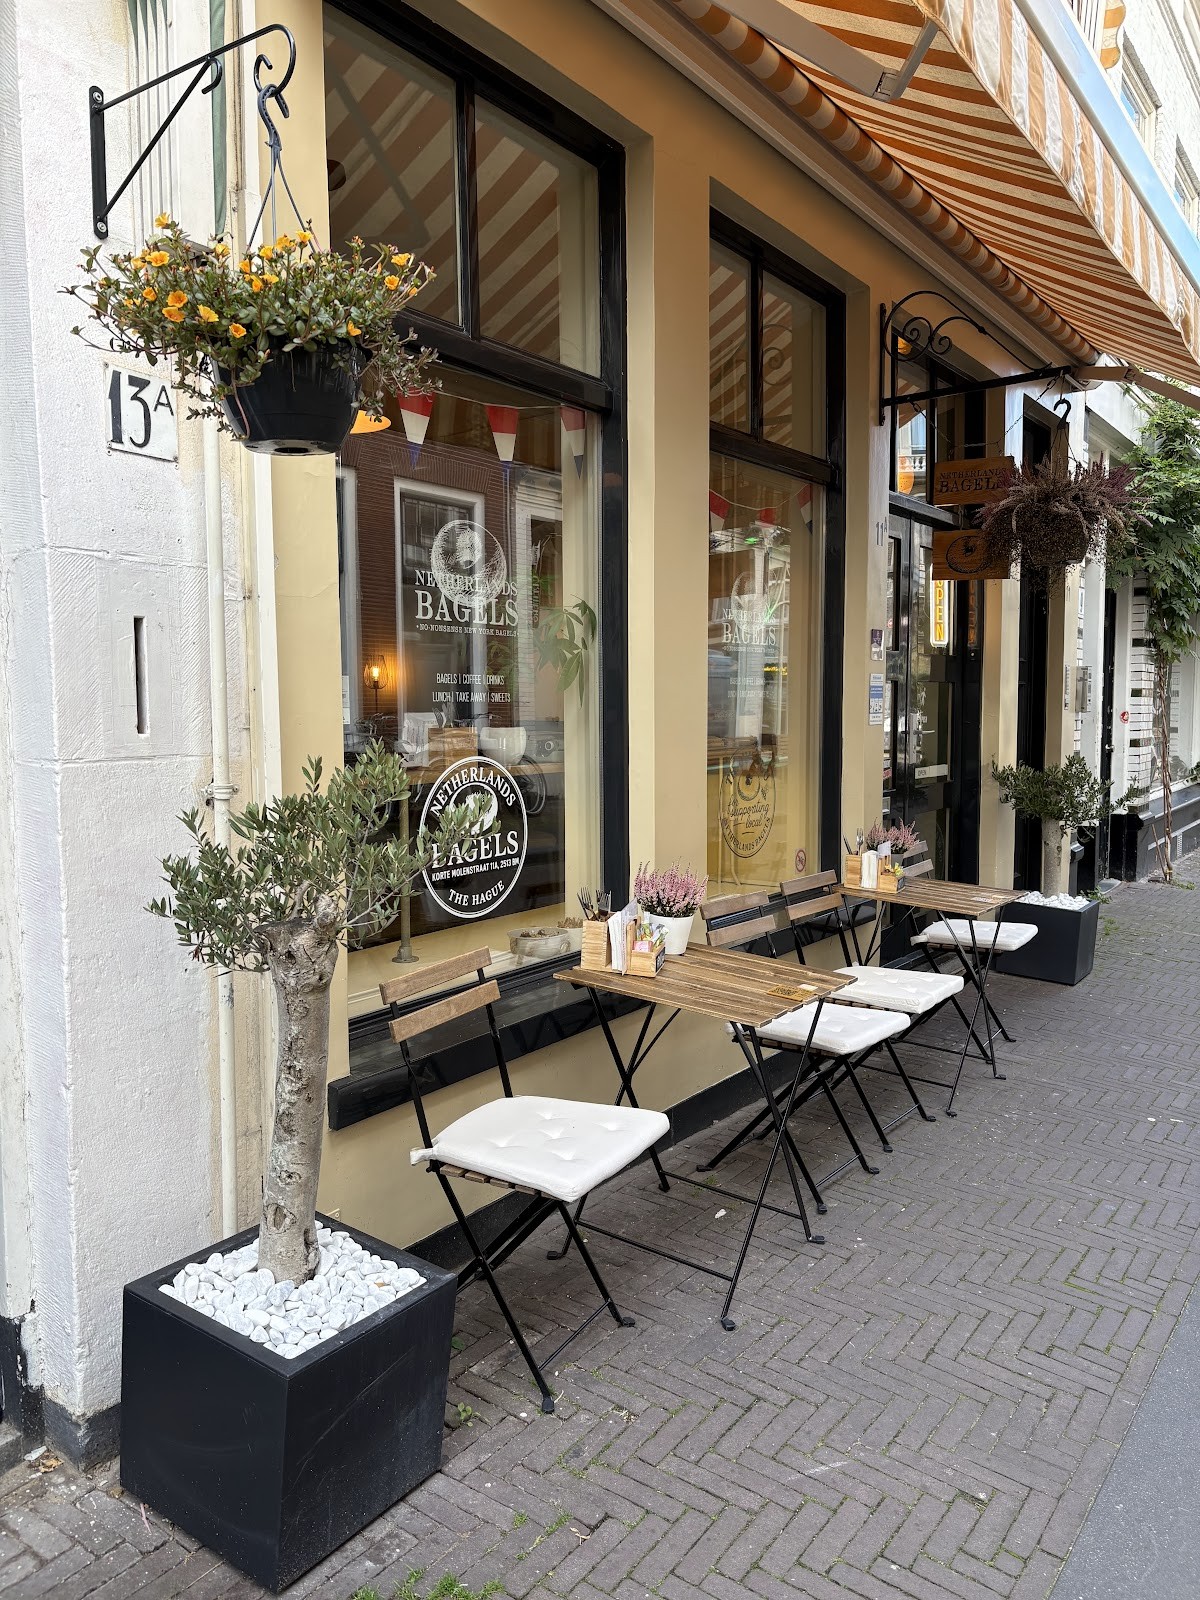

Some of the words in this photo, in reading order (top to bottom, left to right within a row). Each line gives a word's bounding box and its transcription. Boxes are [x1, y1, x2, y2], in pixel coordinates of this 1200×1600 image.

[108, 369, 175, 448] 13A
[414, 569, 518, 597] NETHERLANDS
[414, 589, 519, 627] BAGELS
[479, 628, 495, 636] YORK
[721, 622, 776, 646] BAGELS
[436, 672, 458, 685] BAGELS
[462, 674, 482, 685] COFFEE
[486, 674, 505, 686] DRINKS
[432, 691, 451, 703] LUNCH
[455, 691, 470, 703] TAKE
[470, 692, 487, 703] AWAY
[490, 692, 511, 703] SWEETS
[430, 766, 517, 817] NETHERLANDS
[431, 870, 451, 882] KORTE
[451, 862, 489, 880] MOLENSTRAAT
[500, 859, 511, 869] 2513
[449, 888, 469, 906] THE
[472, 880, 505, 906] HAGUE
